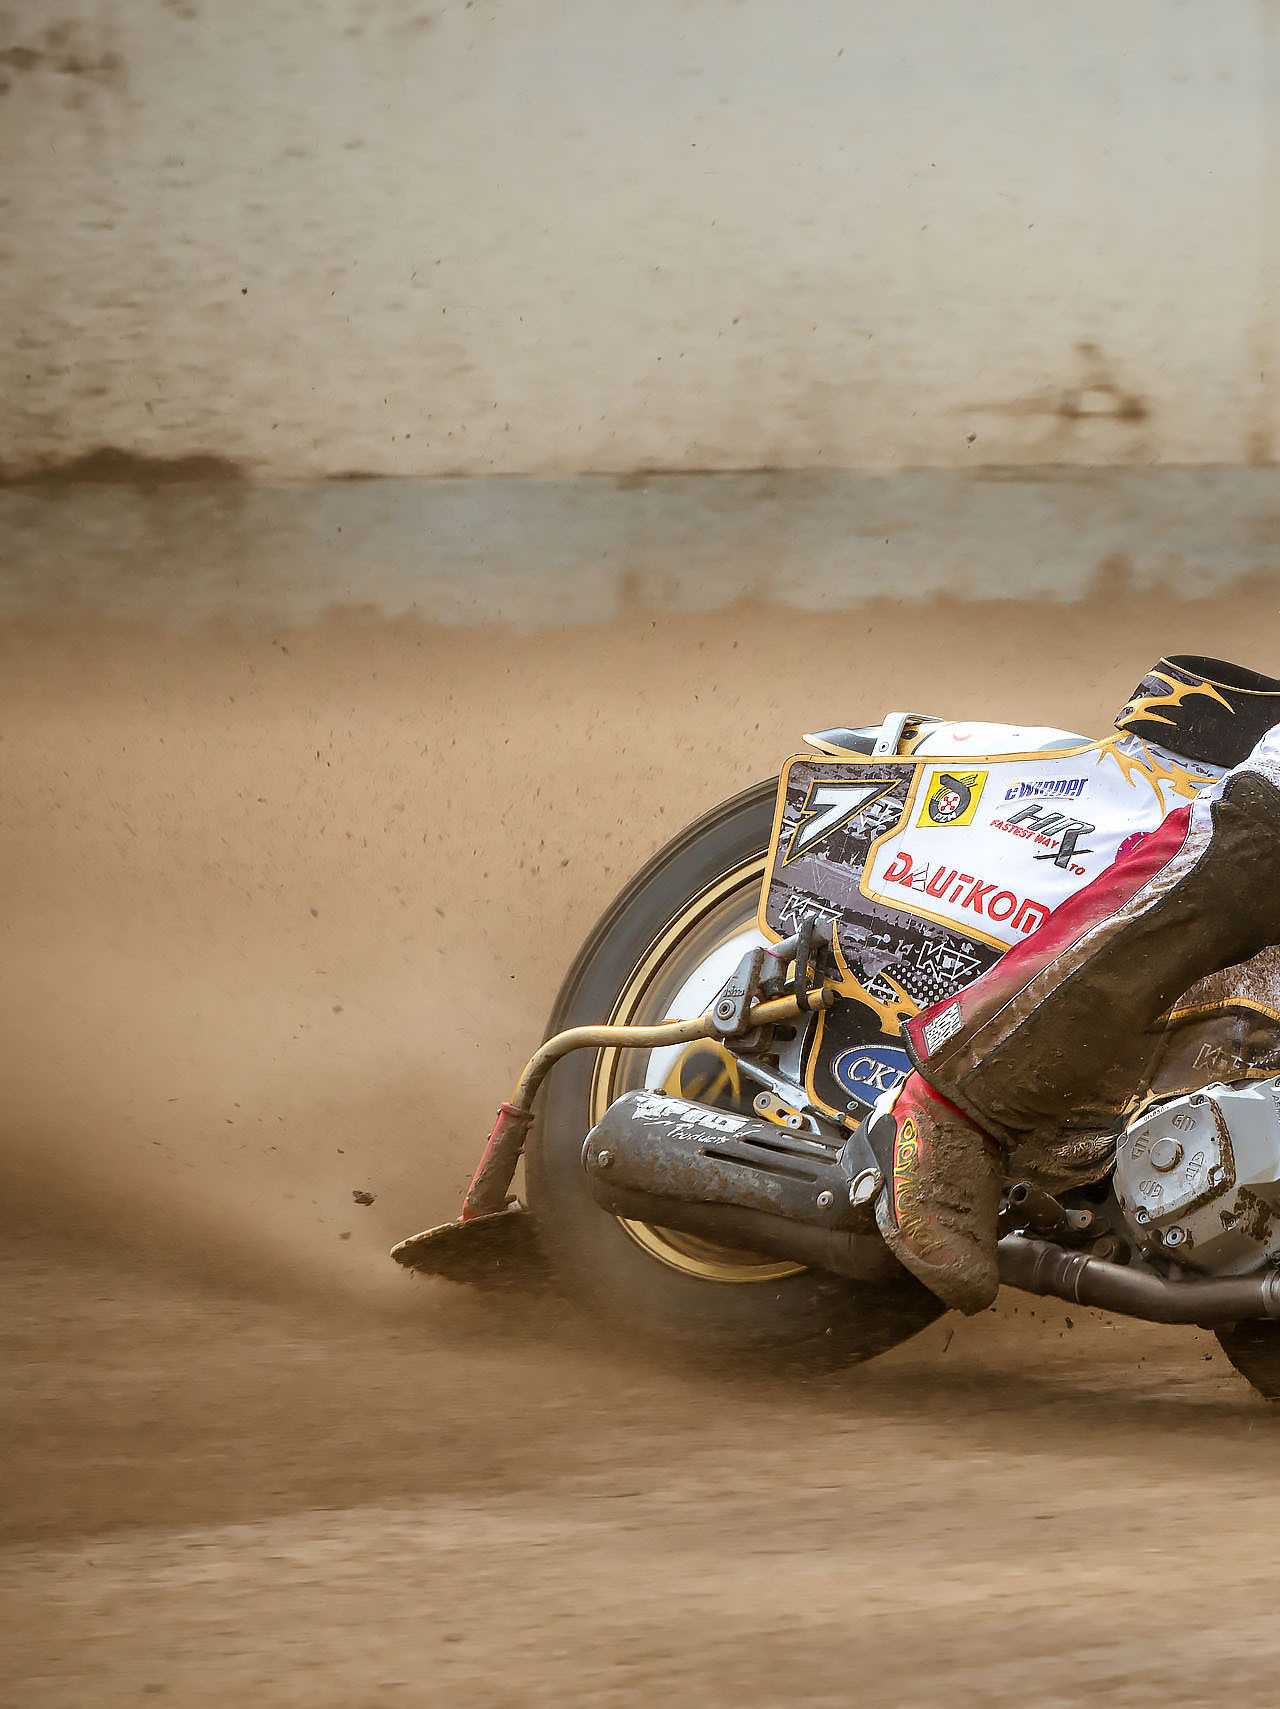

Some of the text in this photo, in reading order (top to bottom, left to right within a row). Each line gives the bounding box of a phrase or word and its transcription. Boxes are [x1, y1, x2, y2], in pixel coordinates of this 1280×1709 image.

[790, 783, 892, 858] 7
[989, 819, 1086, 876] FASTEST WAY TO
[883, 851, 1053, 934] DAUTKOM
